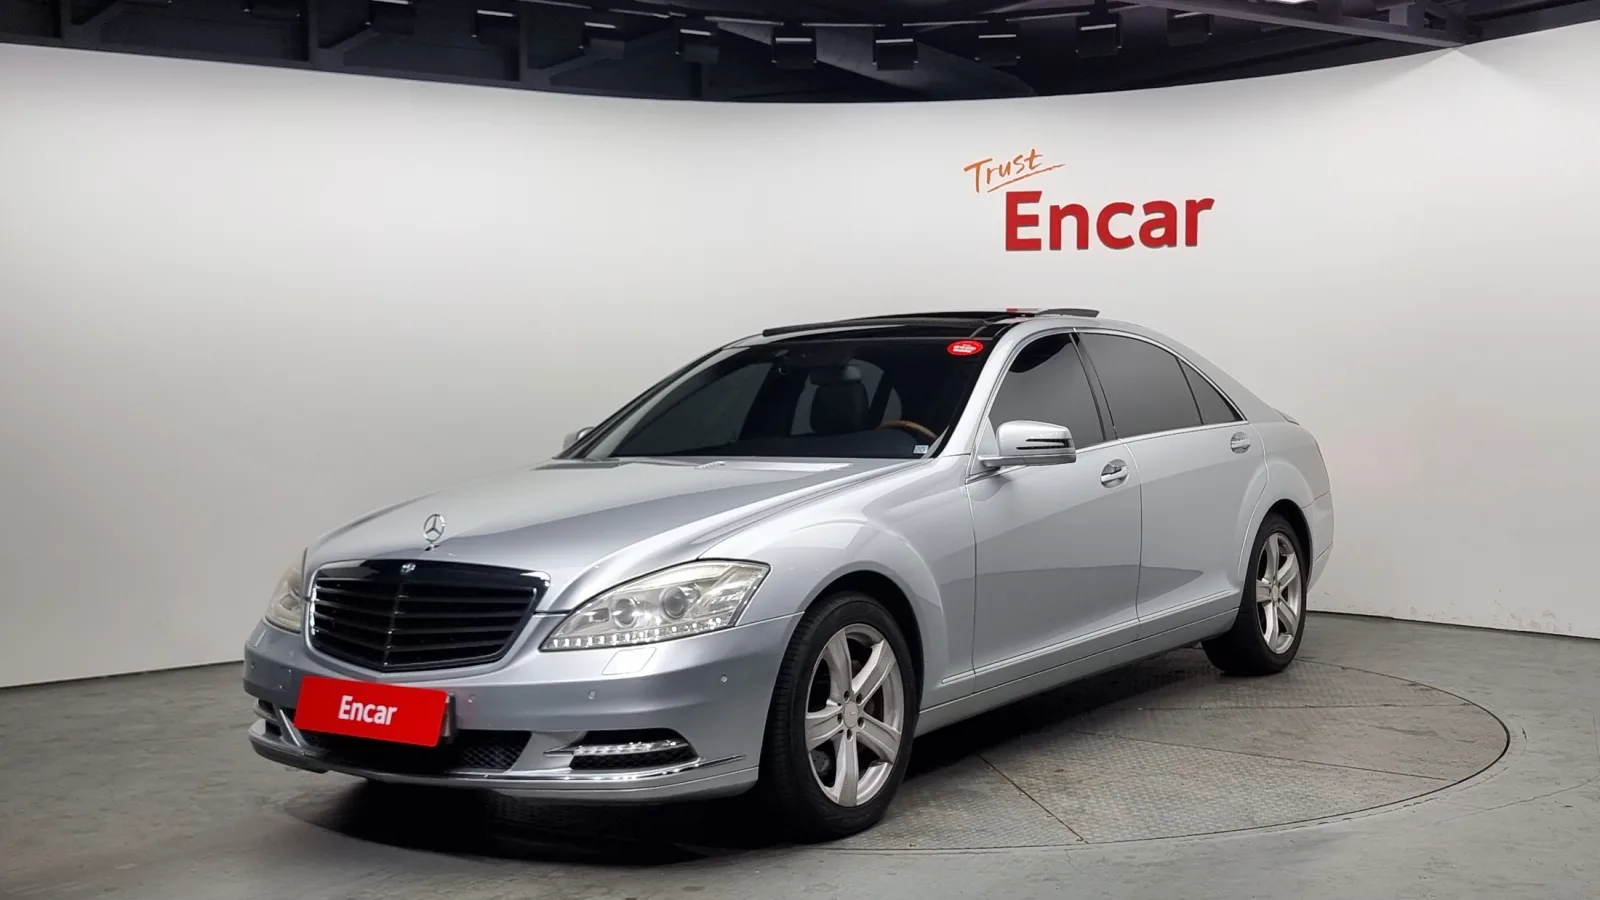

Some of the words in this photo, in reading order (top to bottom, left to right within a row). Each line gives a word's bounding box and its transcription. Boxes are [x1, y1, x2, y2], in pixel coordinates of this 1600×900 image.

[964, 149, 1044, 193] Trust
[1006, 191, 1215, 251] Encar
[338, 695, 398, 725] Encar
